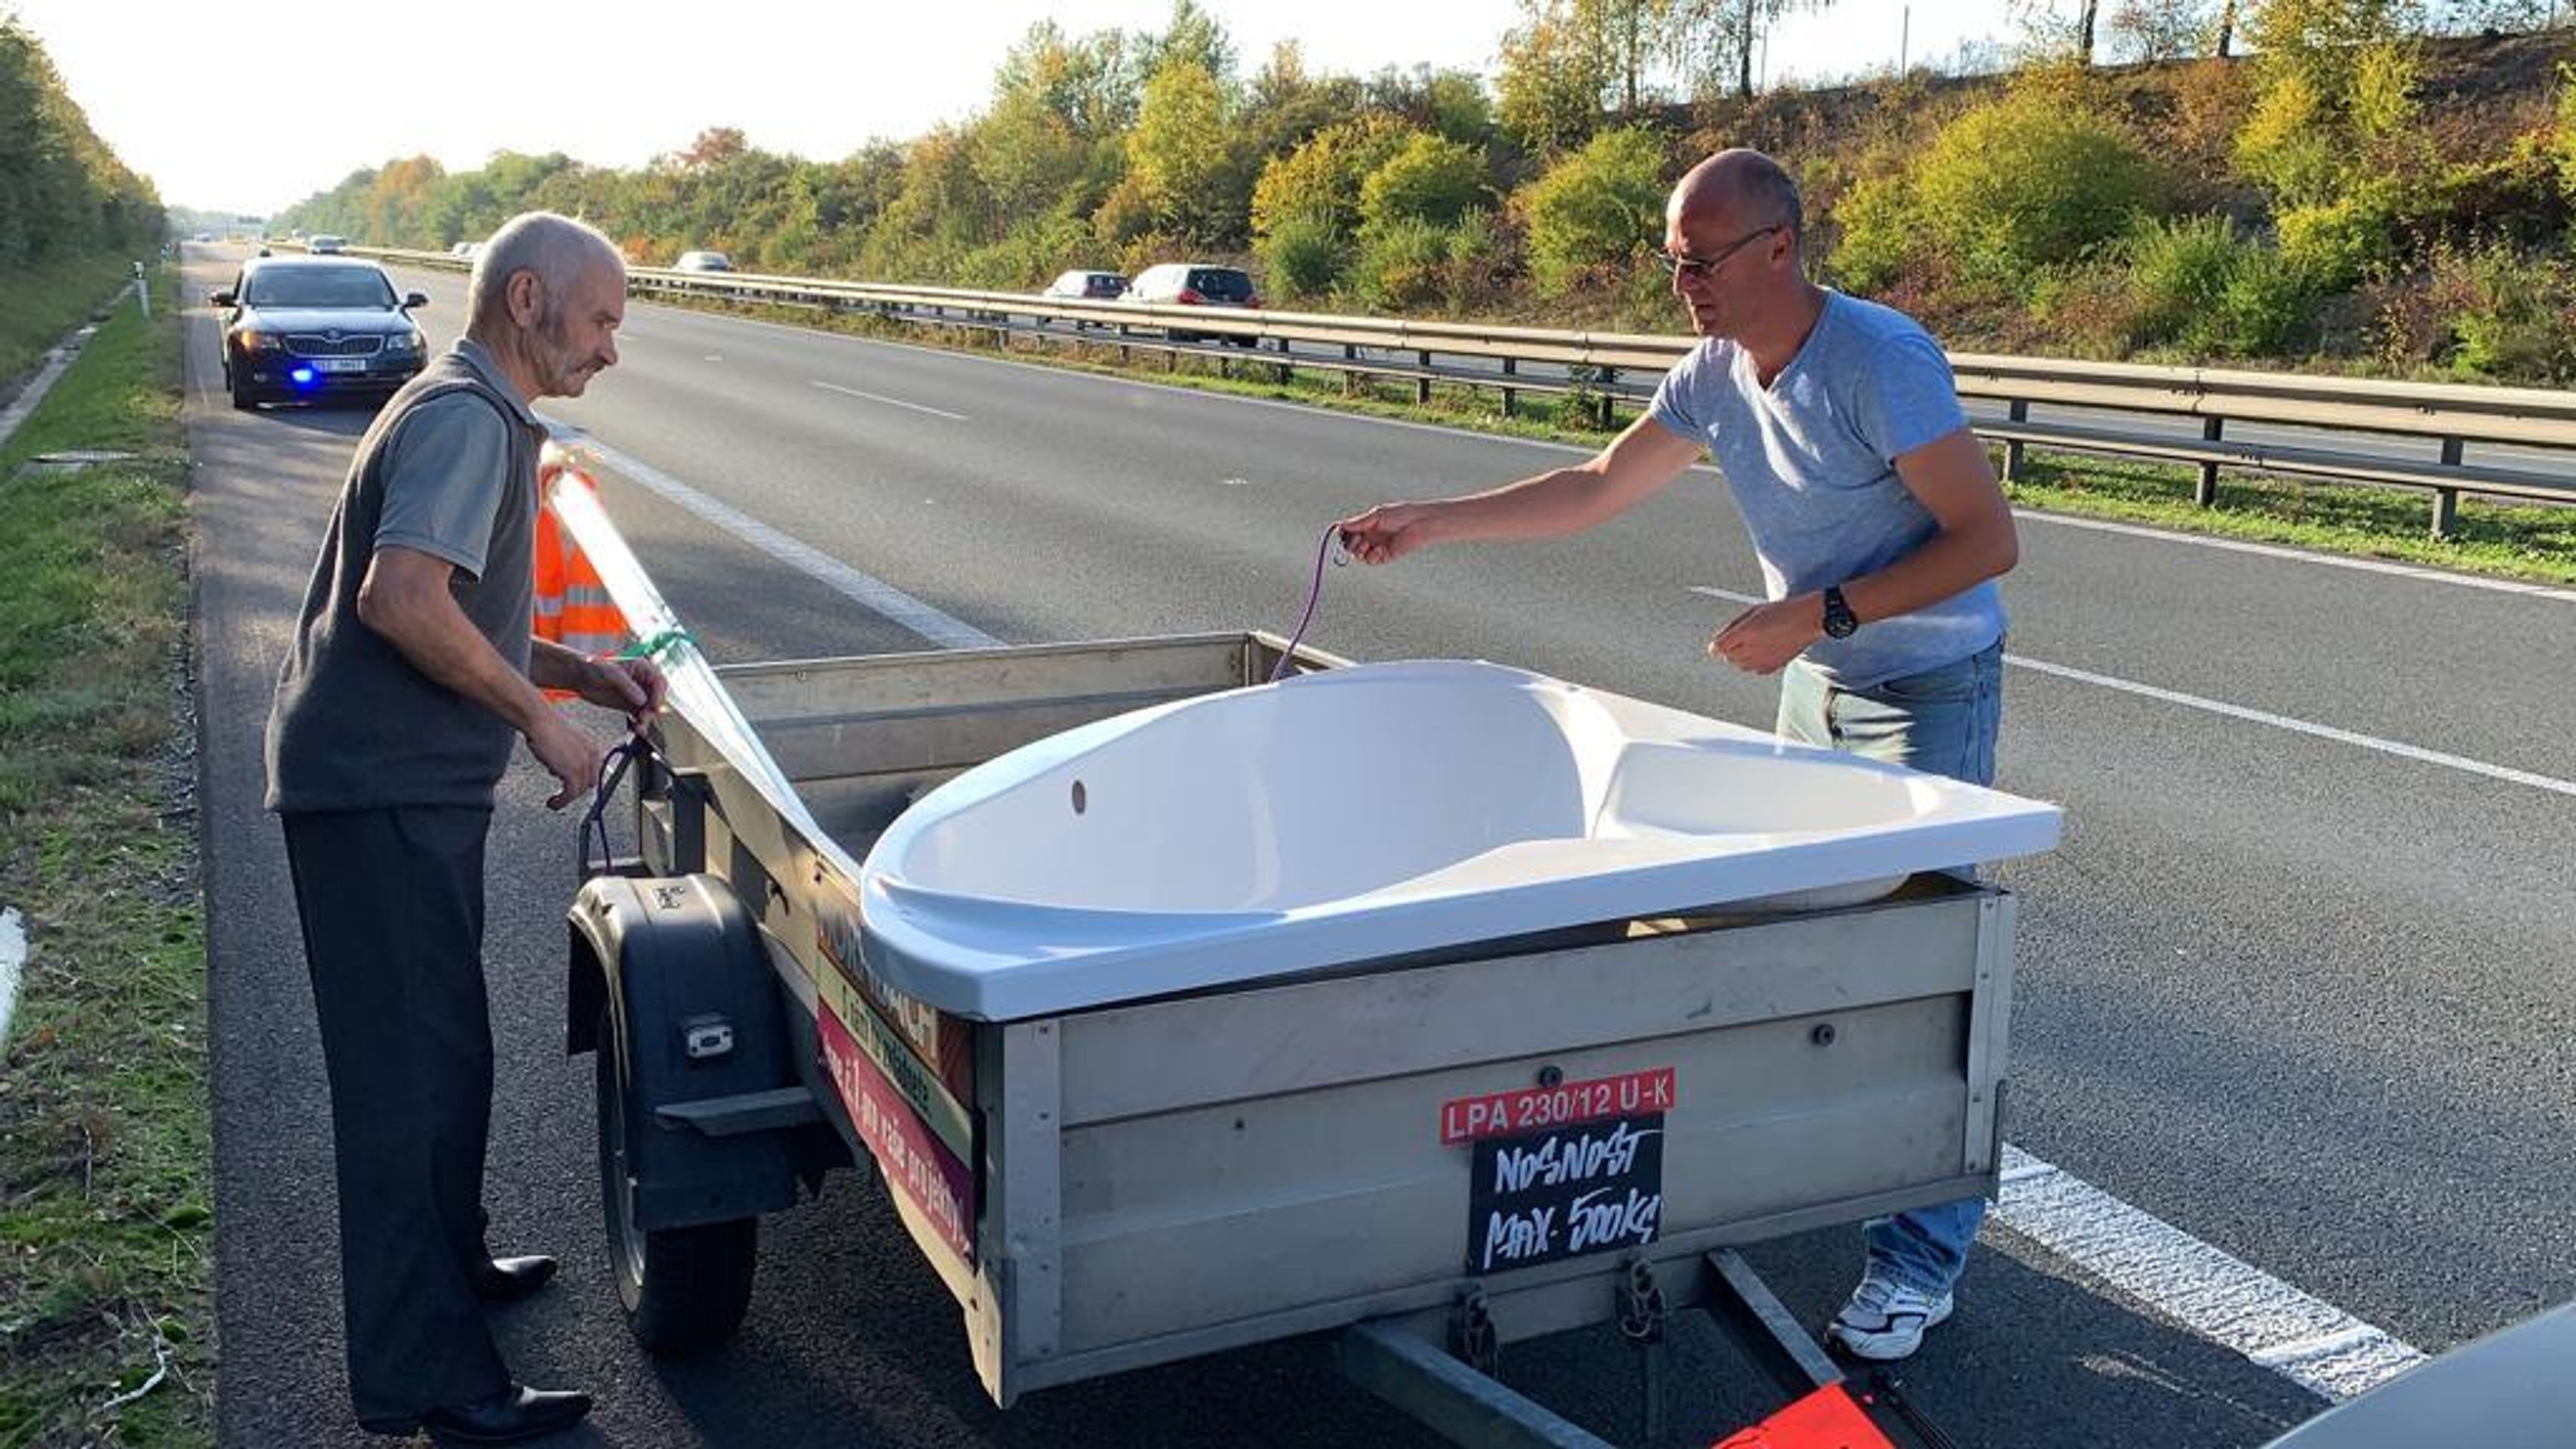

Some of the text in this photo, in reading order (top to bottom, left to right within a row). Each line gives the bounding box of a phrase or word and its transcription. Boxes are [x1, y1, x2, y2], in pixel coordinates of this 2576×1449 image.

[1448, 1075, 1670, 1139] LPA 230/12 U-K
[1494, 1121, 1663, 1193] NOSNOST
